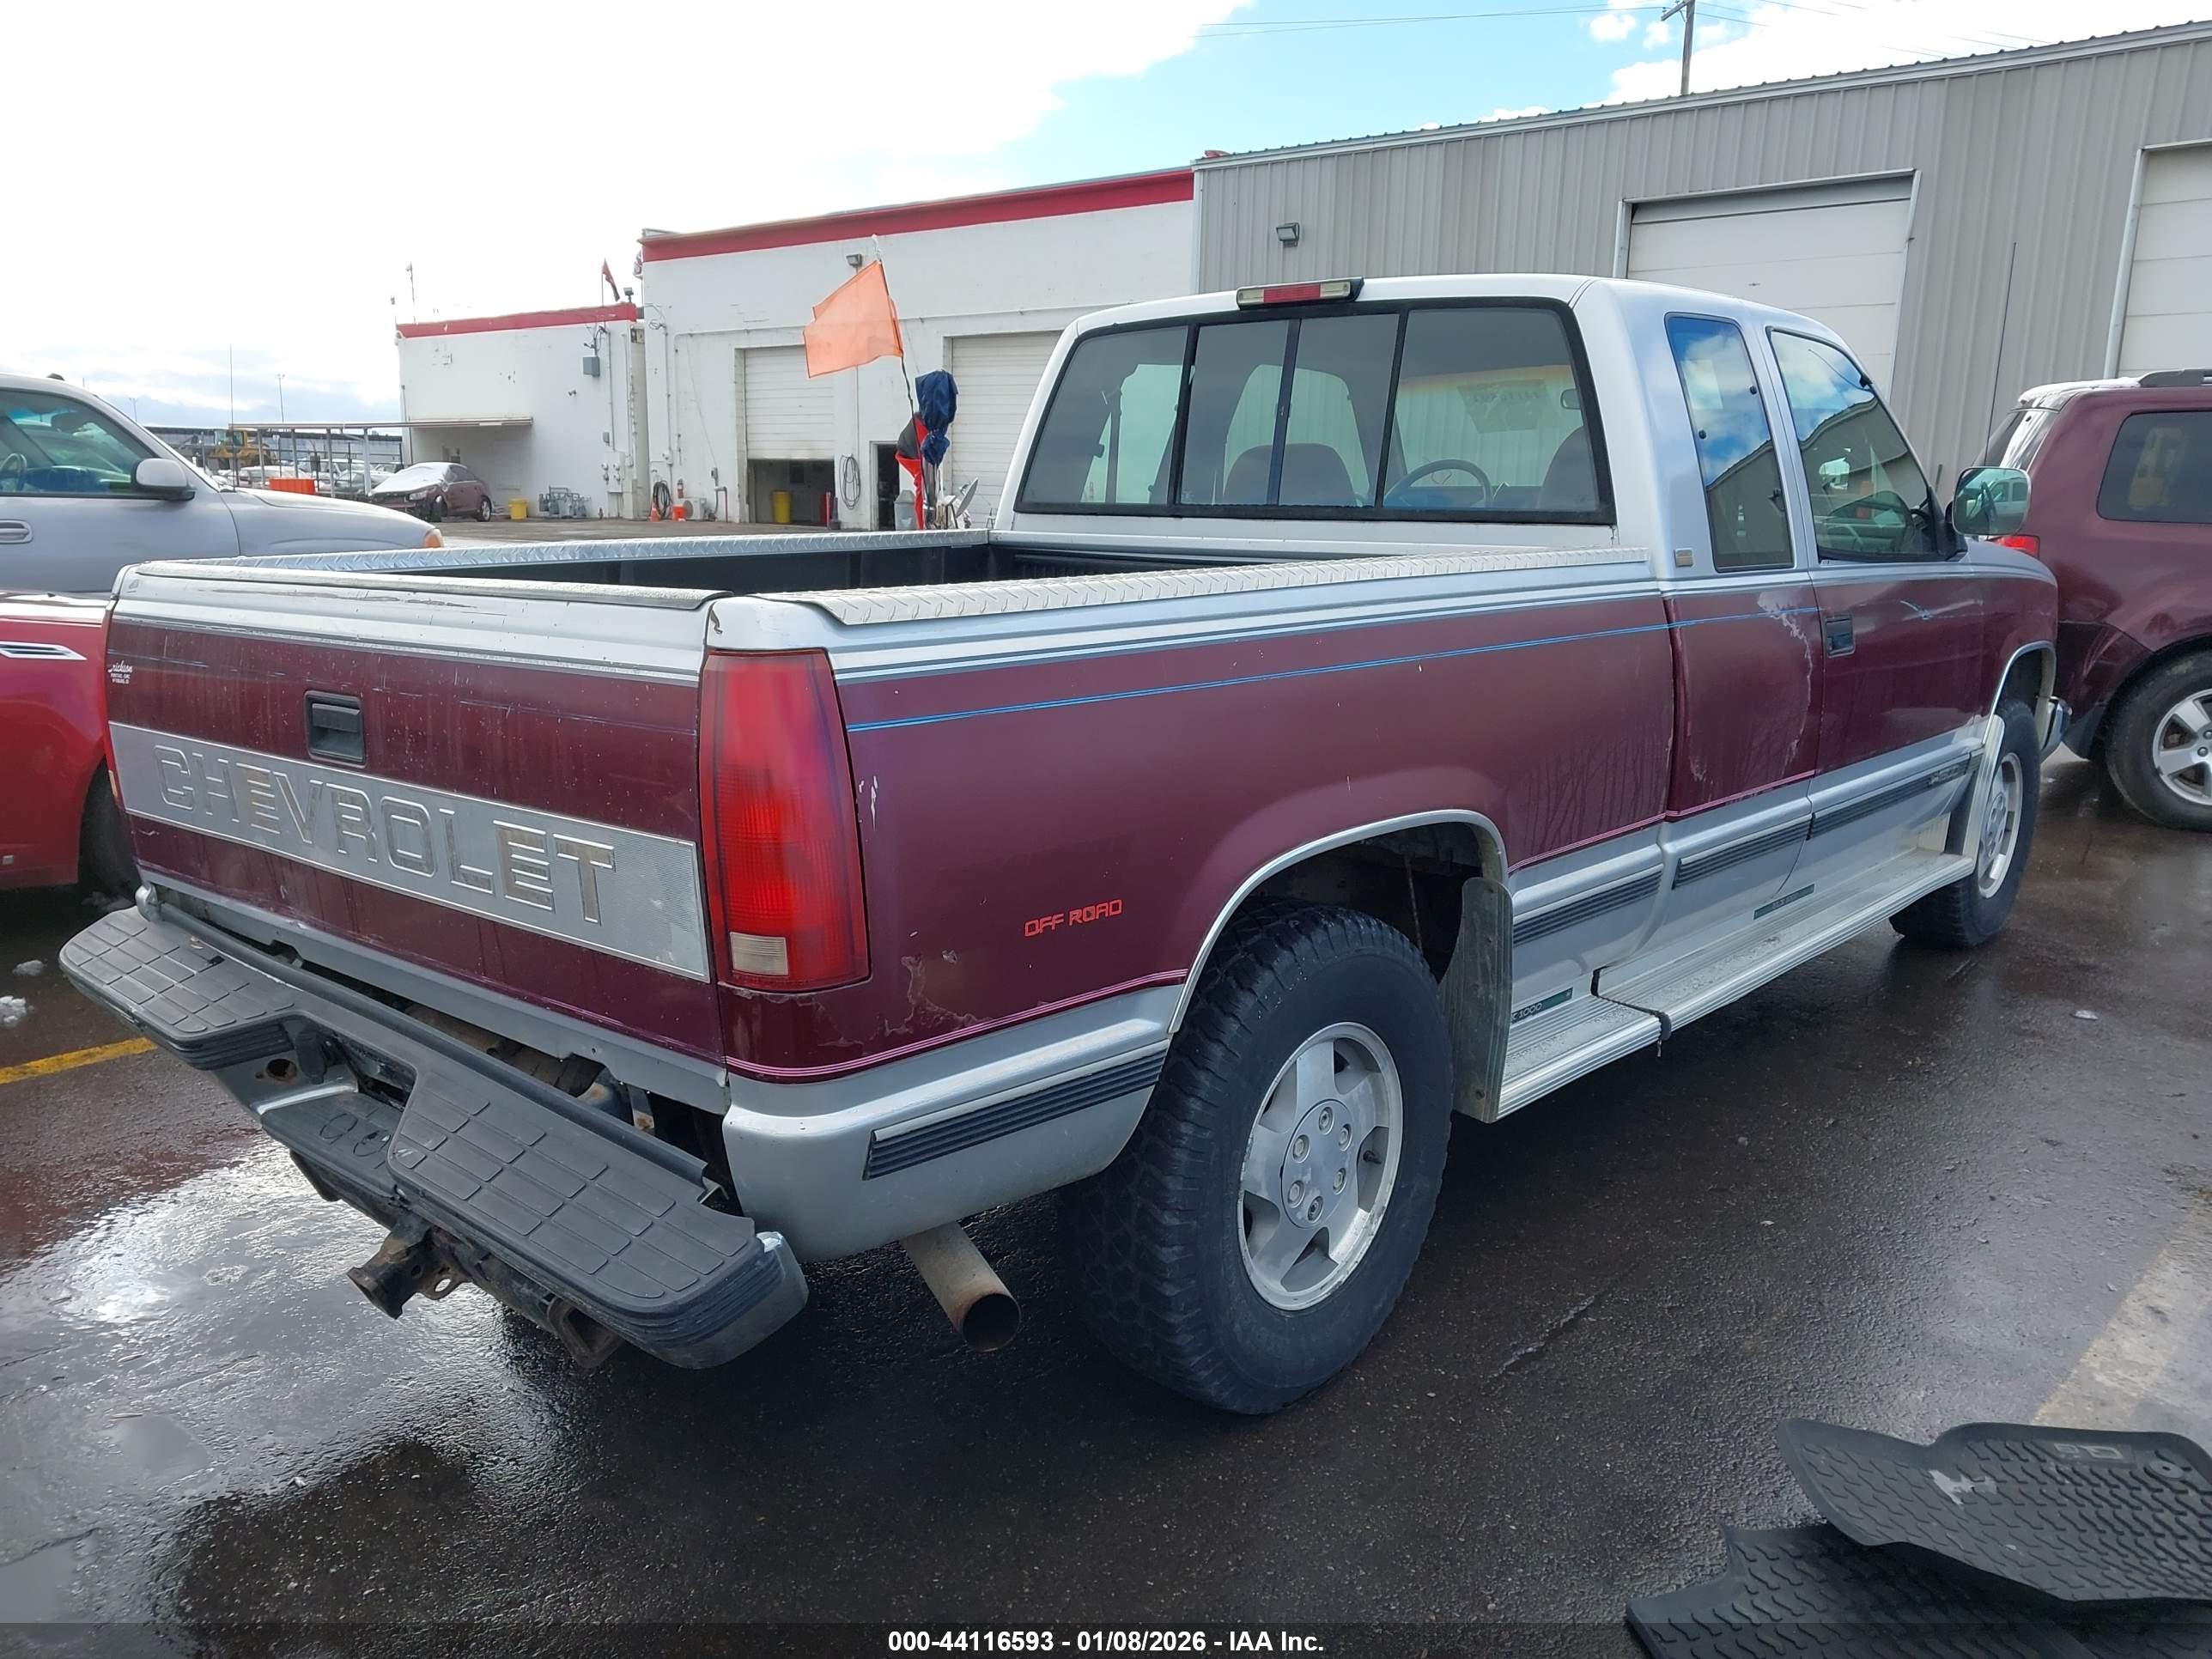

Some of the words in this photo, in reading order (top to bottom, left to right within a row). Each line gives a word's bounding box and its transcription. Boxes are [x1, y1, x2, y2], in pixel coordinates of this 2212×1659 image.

[154, 744, 617, 927] CHEVROLET
[1024, 913, 1065, 937] OFF
[1069, 899, 1122, 927] ROAD
